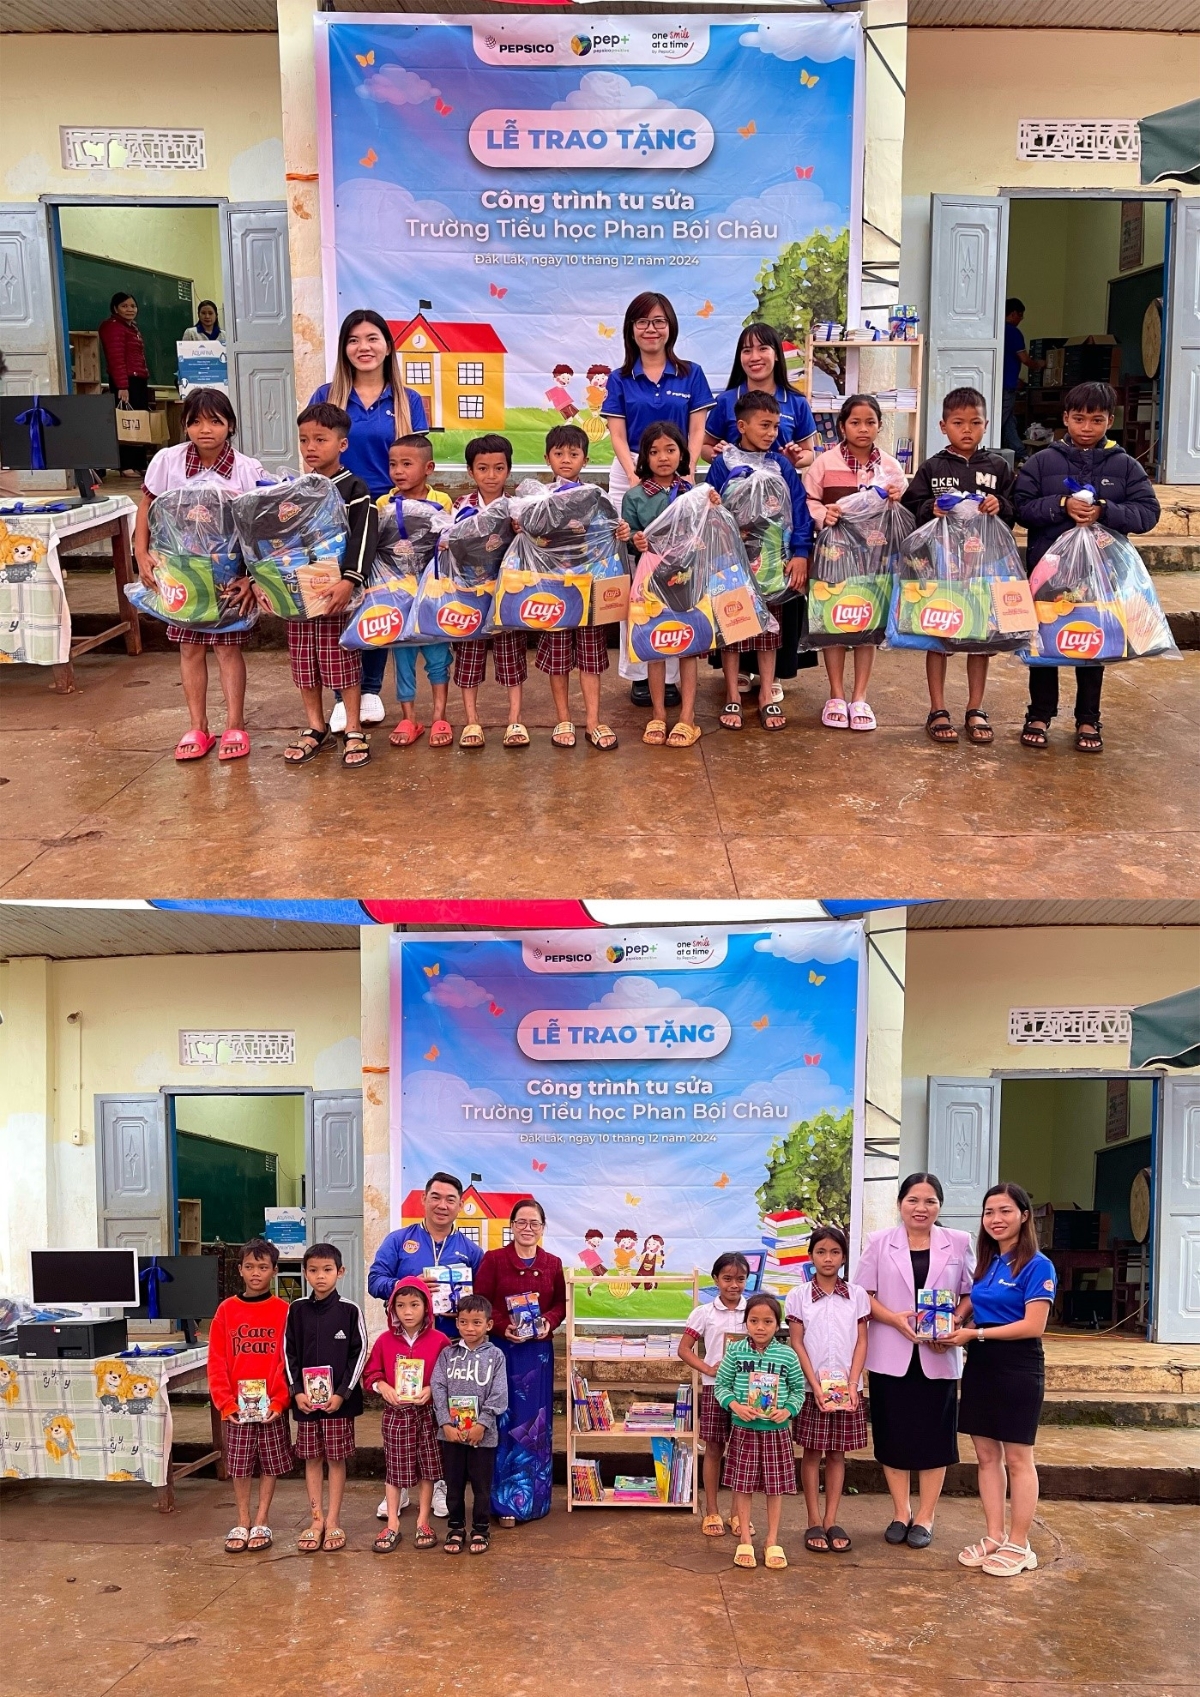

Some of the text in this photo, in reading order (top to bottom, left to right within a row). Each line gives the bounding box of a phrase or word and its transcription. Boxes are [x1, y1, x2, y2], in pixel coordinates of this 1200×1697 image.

[593, 34, 630, 48] pep+
[652, 27, 690, 40] one smile
[500, 44, 554, 54] PEPSICO
[652, 41, 661, 49] at
[669, 40, 689, 49] time
[487, 119, 697, 156] LỄ TRAO TẶNG
[481, 188, 695, 214] Công trình tu sửa
[405, 217, 778, 244] Trường Tiểu học Phan Bội Châu
[532, 254, 562, 267] ngày
[566, 254, 579, 265] 10
[582, 254, 619, 268] tháng
[623, 255, 635, 265] 12
[637, 254, 666, 266] năm
[669, 255, 700, 266] 2024
[931, 477, 960, 488] OKEN
[440, 608, 479, 629] Lay's
[523, 601, 563, 622] Lay's
[835, 602, 871, 626] Lay's
[922, 608, 962, 631] Lay's
[362, 610, 400, 640] Lay's
[654, 627, 691, 648] Lay's
[1060, 630, 1103, 653] Lay's
[625, 943, 658, 957] pep+
[677, 948, 685, 956] at
[692, 948, 710, 956] time
[692, 937, 711, 948] smile
[545, 953, 592, 963] PEPSICO
[532, 1018, 715, 1049] LỄ TRAO TẶNG
[526, 1075, 713, 1099] Công trình tu sửa
[461, 1101, 788, 1124] Trường Tiểu học Phan Bội Châu
[569, 1134, 596, 1145] ngày
[599, 1133, 610, 1143] 10
[612, 1133, 645, 1145] tháng
[648, 1134, 659, 1143] 12
[690, 1133, 717, 1143] 2024
[237, 1323, 276, 1339] Care
[232, 1336, 277, 1357] Bears
